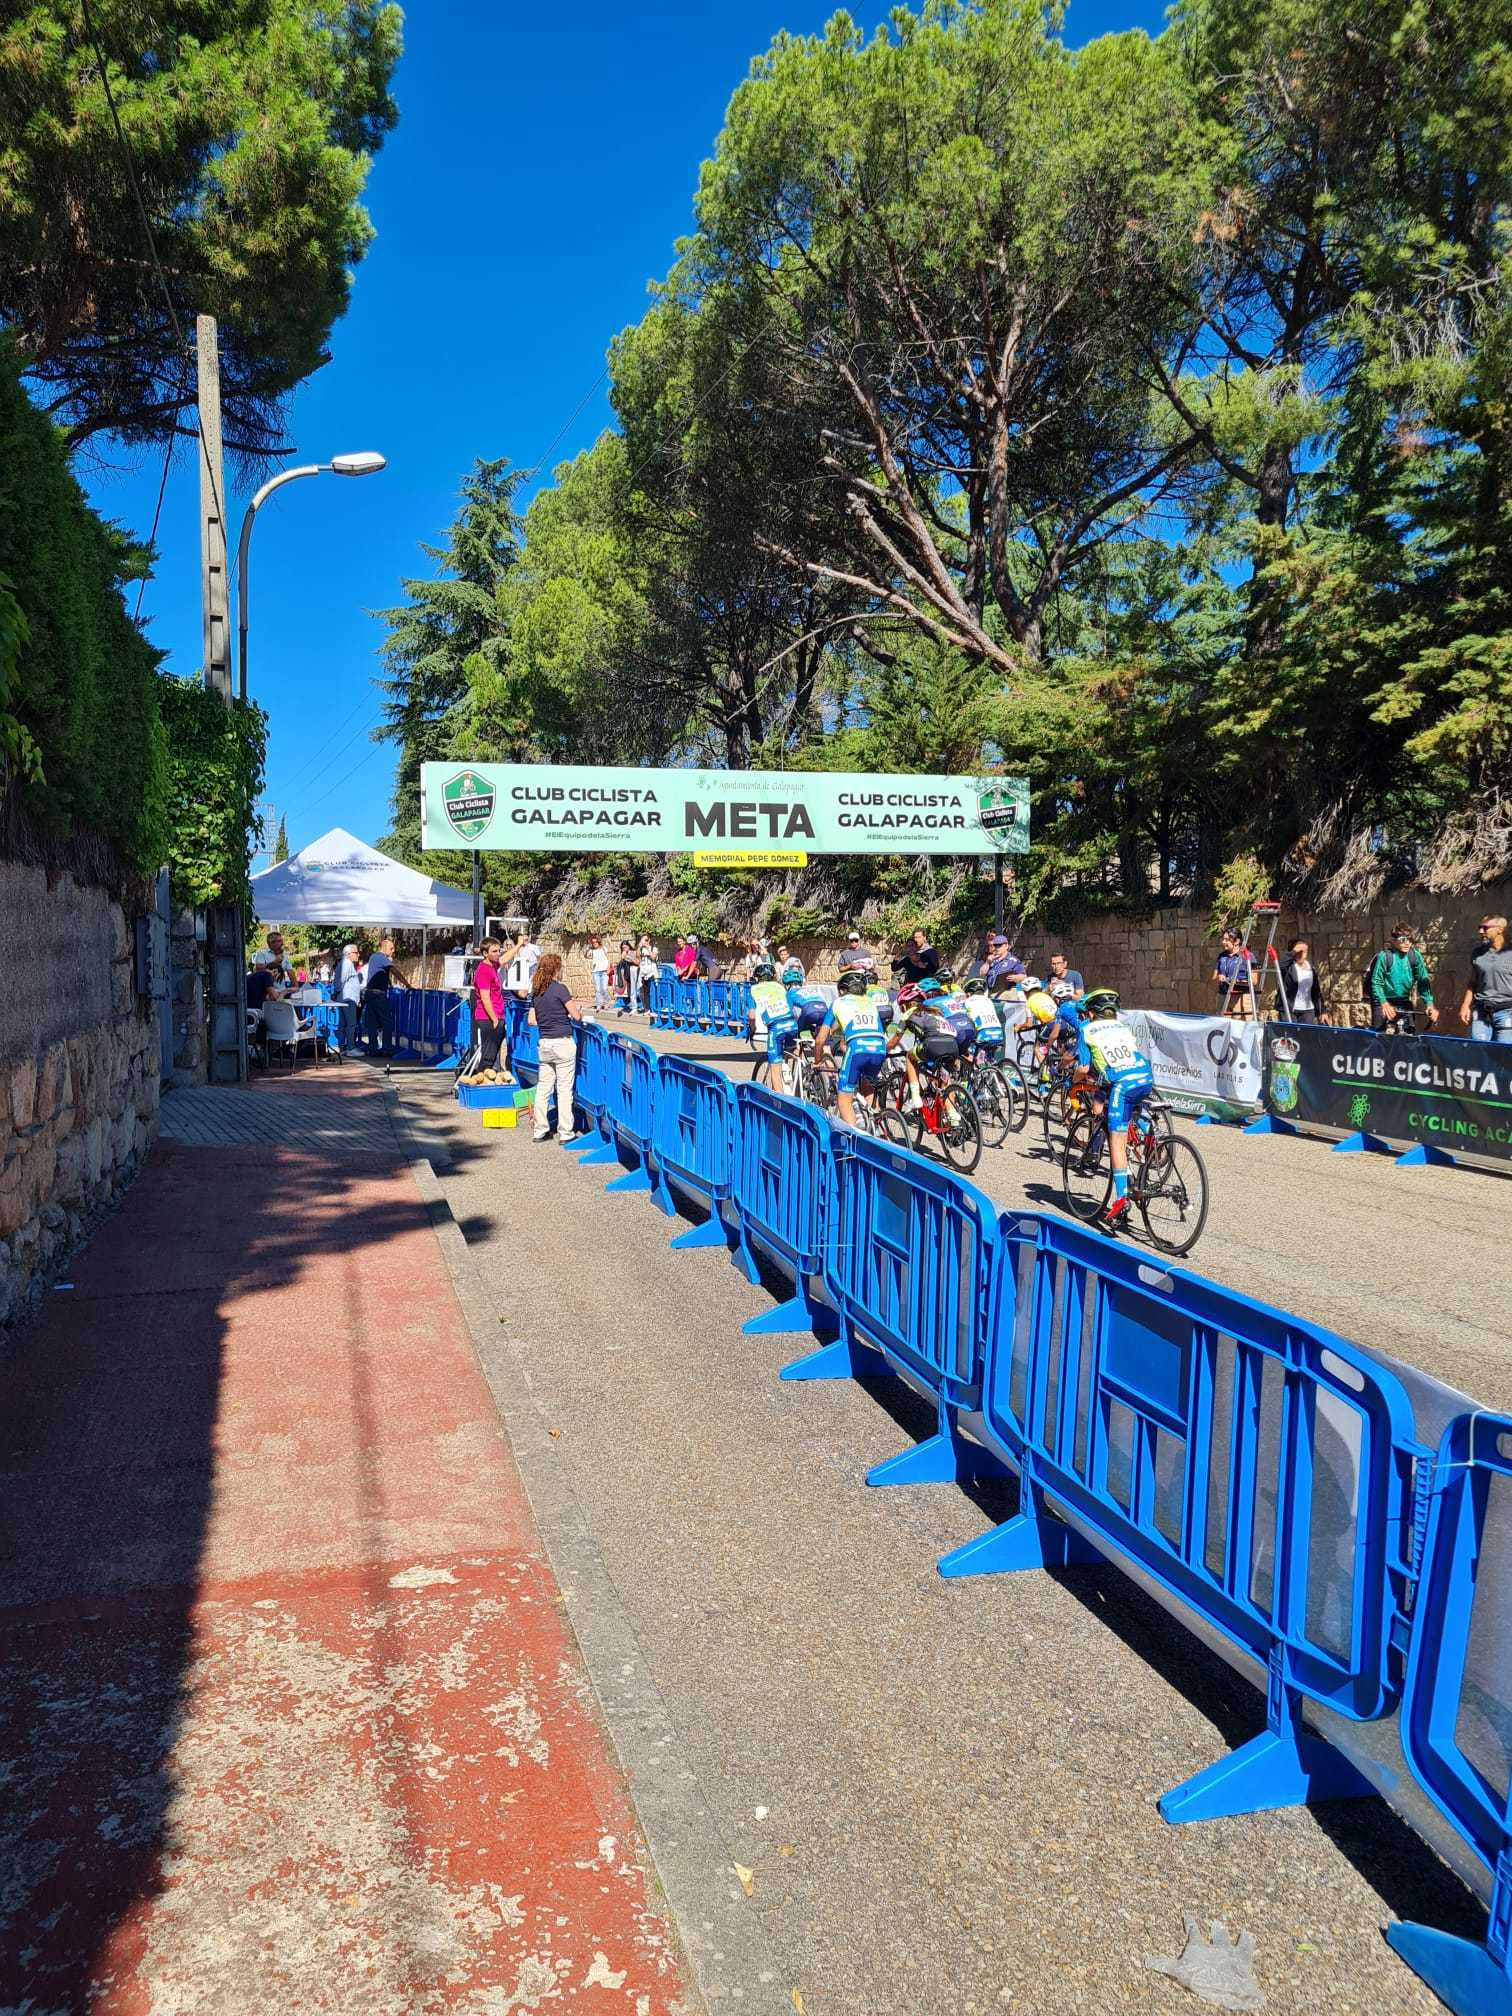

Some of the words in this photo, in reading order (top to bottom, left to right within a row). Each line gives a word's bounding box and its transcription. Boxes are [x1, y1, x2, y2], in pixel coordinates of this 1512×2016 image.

[511, 787, 564, 801] CLUB
[568, 788, 658, 803] CICLISTA
[838, 793, 884, 806] CLUB
[887, 794, 962, 807] CICLISTA
[449, 801, 465, 810] Club
[465, 799, 489, 809] Ciclista
[451, 807, 490, 820] GALAPAGAR
[511, 808, 662, 826] GALAPAGAR
[684, 801, 816, 838] META
[838, 813, 965, 828] GALAPAGAR
[701, 855, 746, 863] MEMORIAL
[747, 855, 768, 863] PEPE
[855, 1014, 874, 1025] 307
[1106, 1045, 1132, 1064] 308
[1331, 1054, 1385, 1078] CLUB
[1393, 1060, 1499, 1096] CICLISTA
[1408, 1112, 1479, 1138] CYCLING
